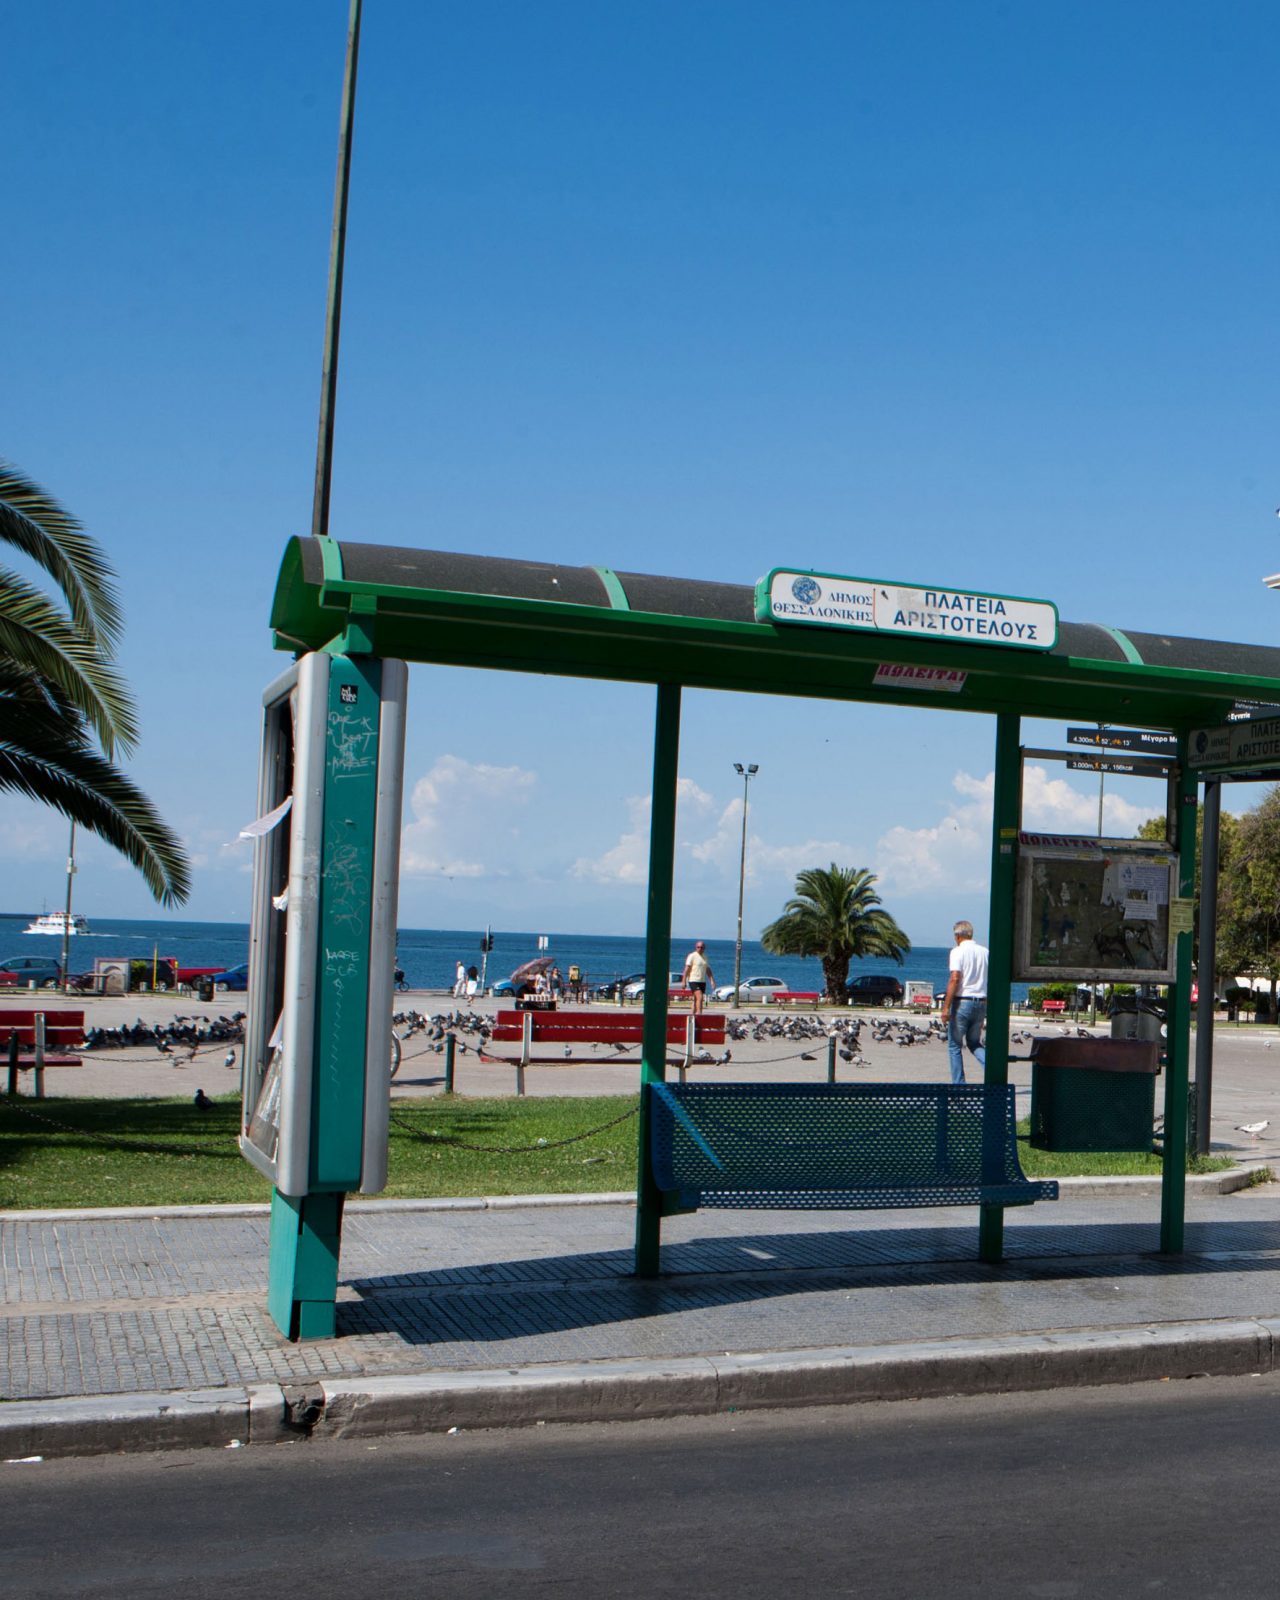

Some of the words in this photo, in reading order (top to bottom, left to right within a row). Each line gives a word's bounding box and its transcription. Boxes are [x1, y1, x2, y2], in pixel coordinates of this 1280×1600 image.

[828, 592, 873, 606] ΔΗΜΟΣ
[924, 591, 1006, 616] ΠΛΑΤΕΙΑ
[773, 602, 873, 622] ΘΕΣΣΑΛΟΝΙΚΗΣ
[893, 609, 1037, 641] ΑΡΙΣΤΟΤΕΛΟΥΣ
[877, 663, 966, 682] ΠΩΛΕΙΤΑΙ
